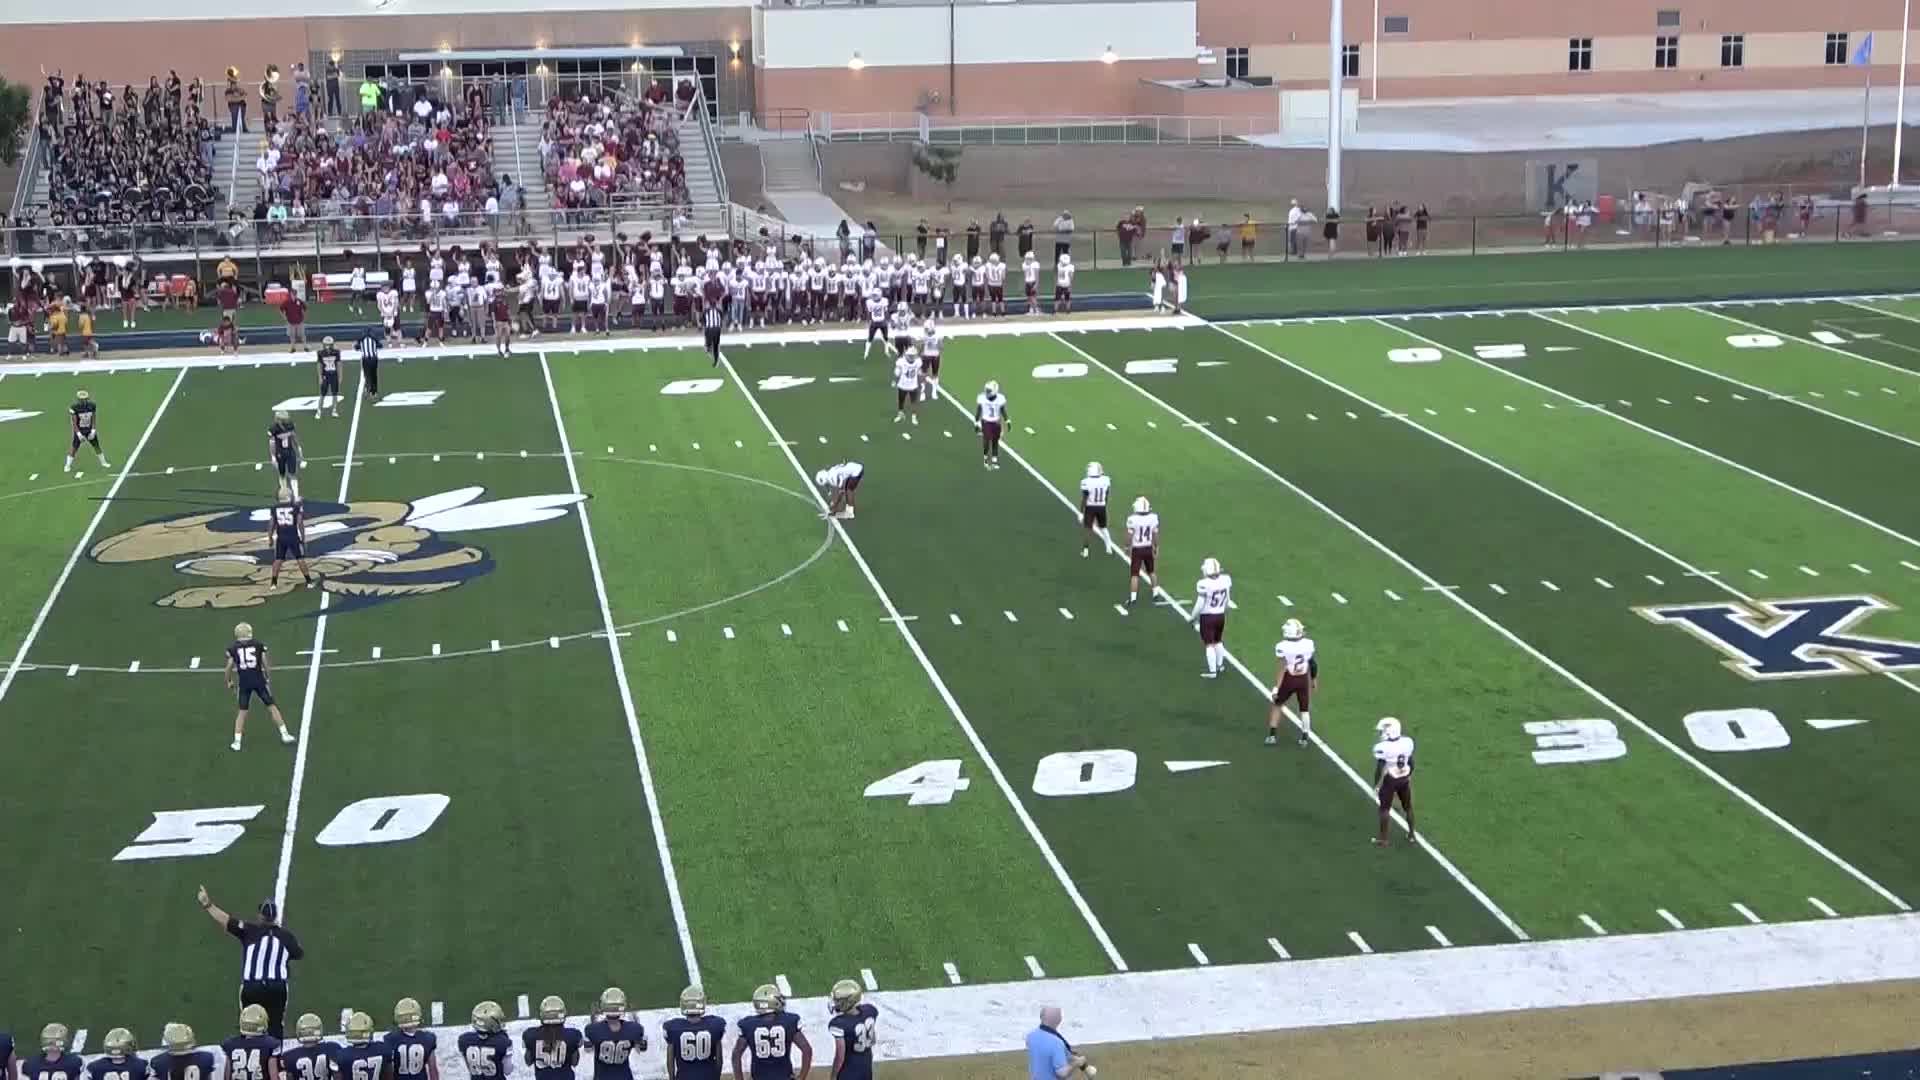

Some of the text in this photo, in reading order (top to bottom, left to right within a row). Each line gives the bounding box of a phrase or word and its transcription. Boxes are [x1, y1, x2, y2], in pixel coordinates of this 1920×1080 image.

[1545, 163, 1580, 206] K
[1093, 487, 1105, 502] 11
[275, 507, 295, 526] 55
[1138, 525, 1151, 542] 14
[1629, 595, 1920, 681] K
[237, 646, 258, 670] 15
[1293, 654, 1305, 672] 2
[535, 1039, 567, 1069] 50
[679, 1030, 712, 1062] 60
[753, 1025, 786, 1058] 63
[231, 1048, 263, 1080] 24
[296, 1054, 329, 1080] 34
[351, 1055, 384, 1080] 67
[397, 1043, 425, 1076] 18
[466, 1045, 497, 1077] 85
